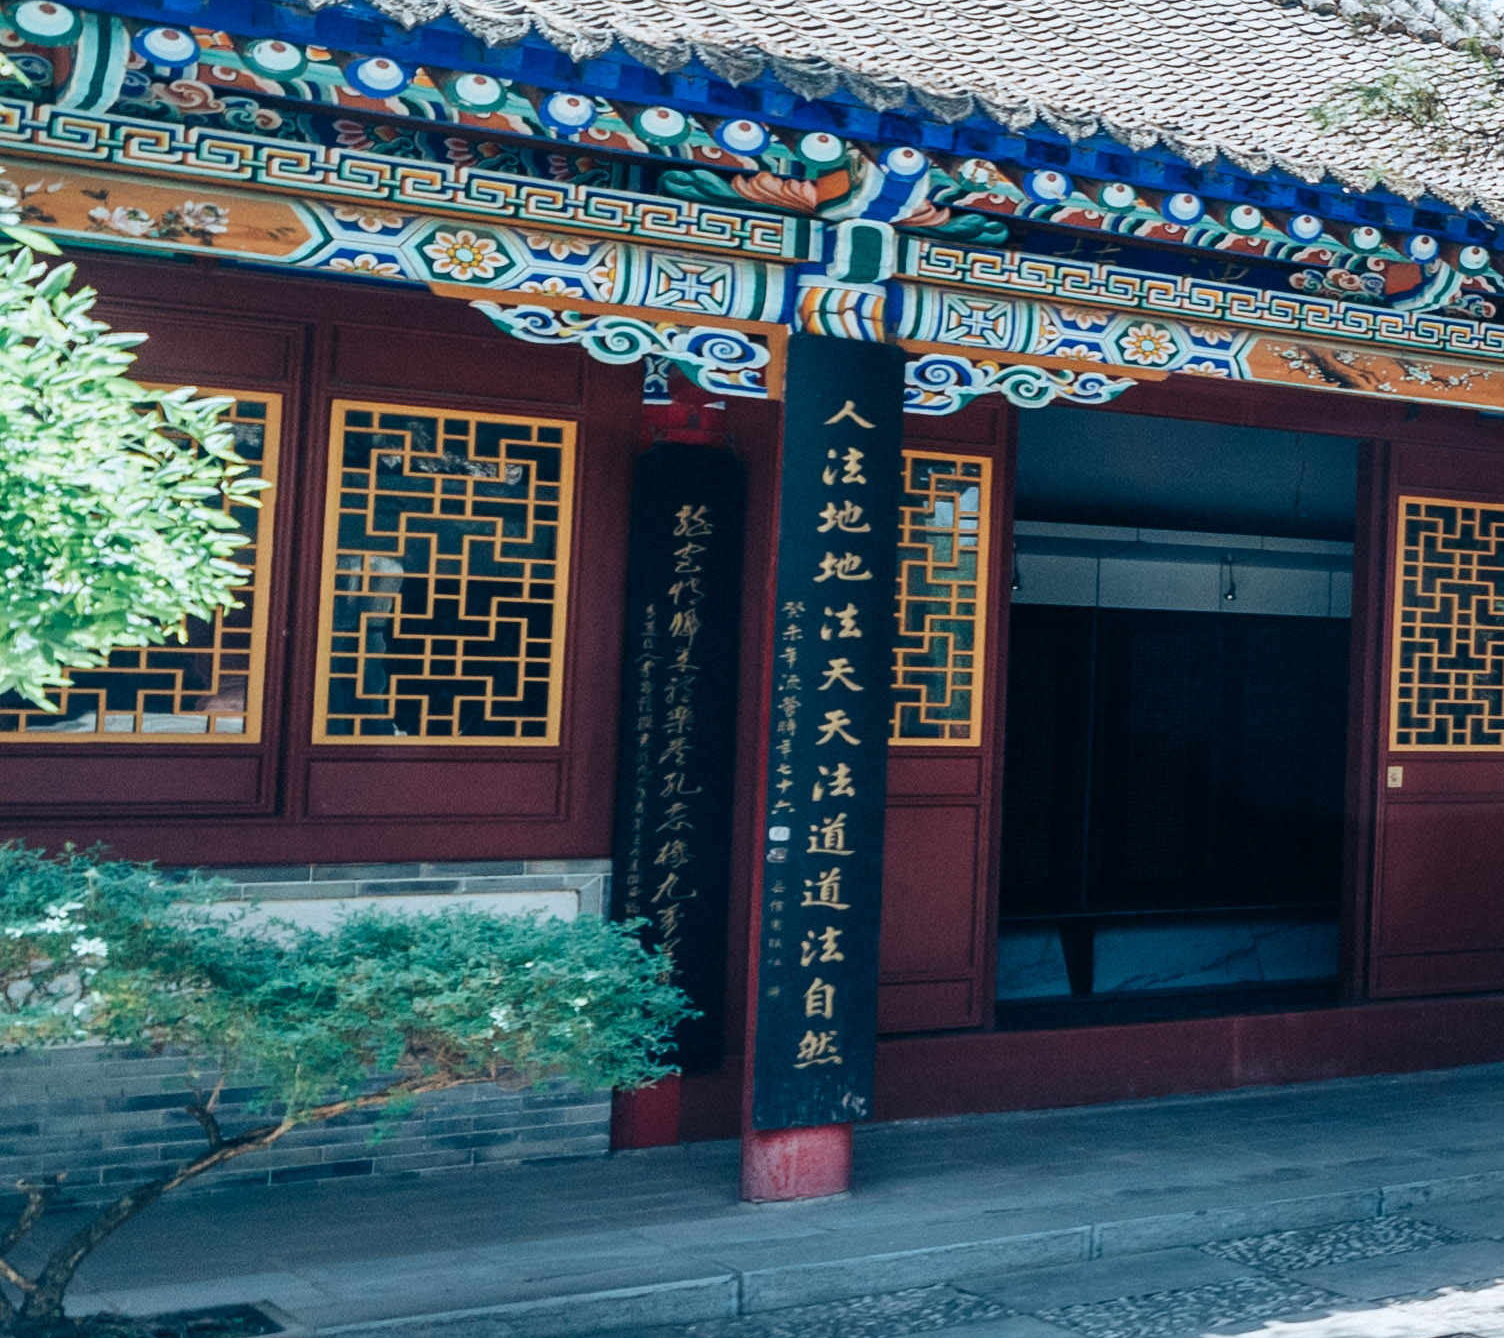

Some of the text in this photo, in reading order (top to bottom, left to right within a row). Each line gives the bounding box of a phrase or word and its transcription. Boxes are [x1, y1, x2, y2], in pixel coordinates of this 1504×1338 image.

[793, 400, 876, 1069] 人法地地法天天法道道法自然
